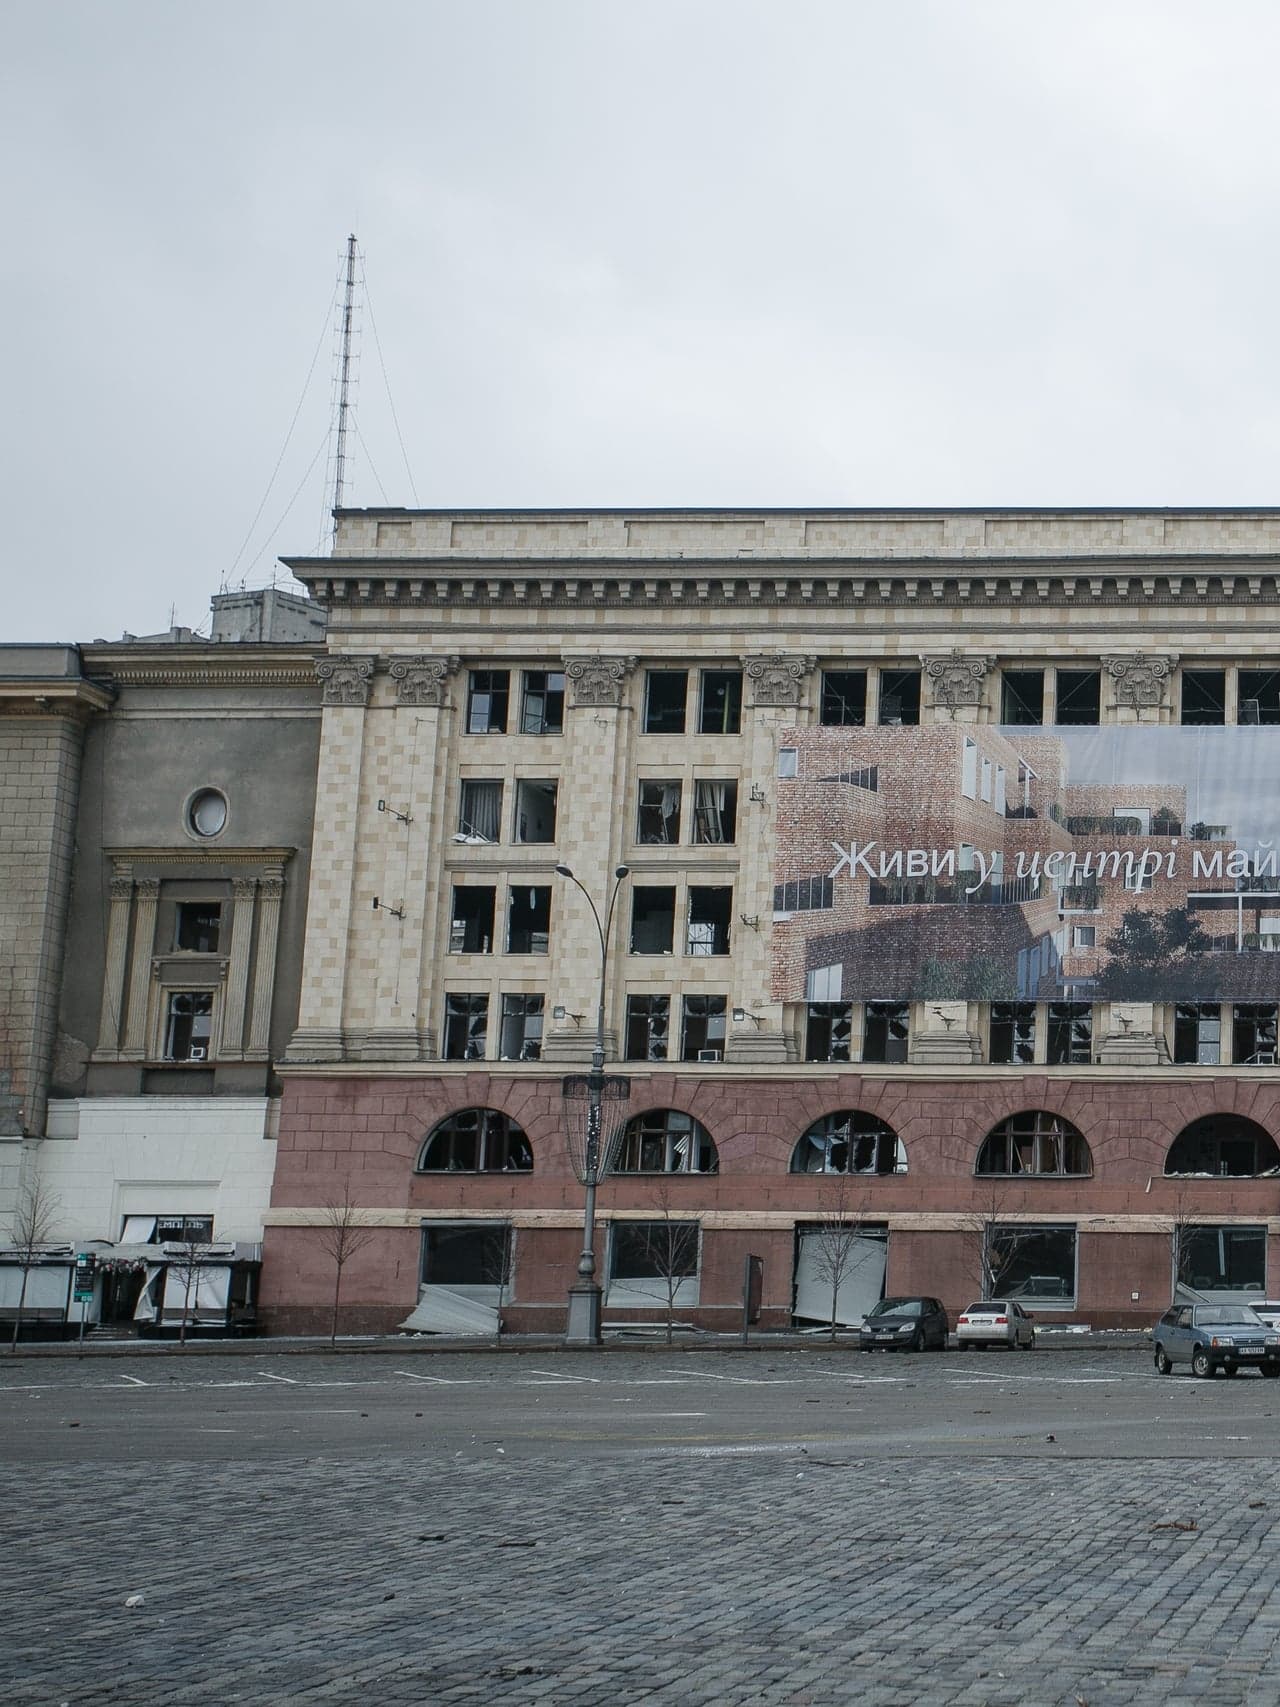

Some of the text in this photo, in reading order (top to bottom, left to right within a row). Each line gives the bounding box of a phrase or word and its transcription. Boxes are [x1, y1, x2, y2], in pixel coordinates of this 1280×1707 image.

[829, 841, 955, 878] Живи
[966, 847, 998, 893] у
[1014, 839, 1178, 892] центрі
